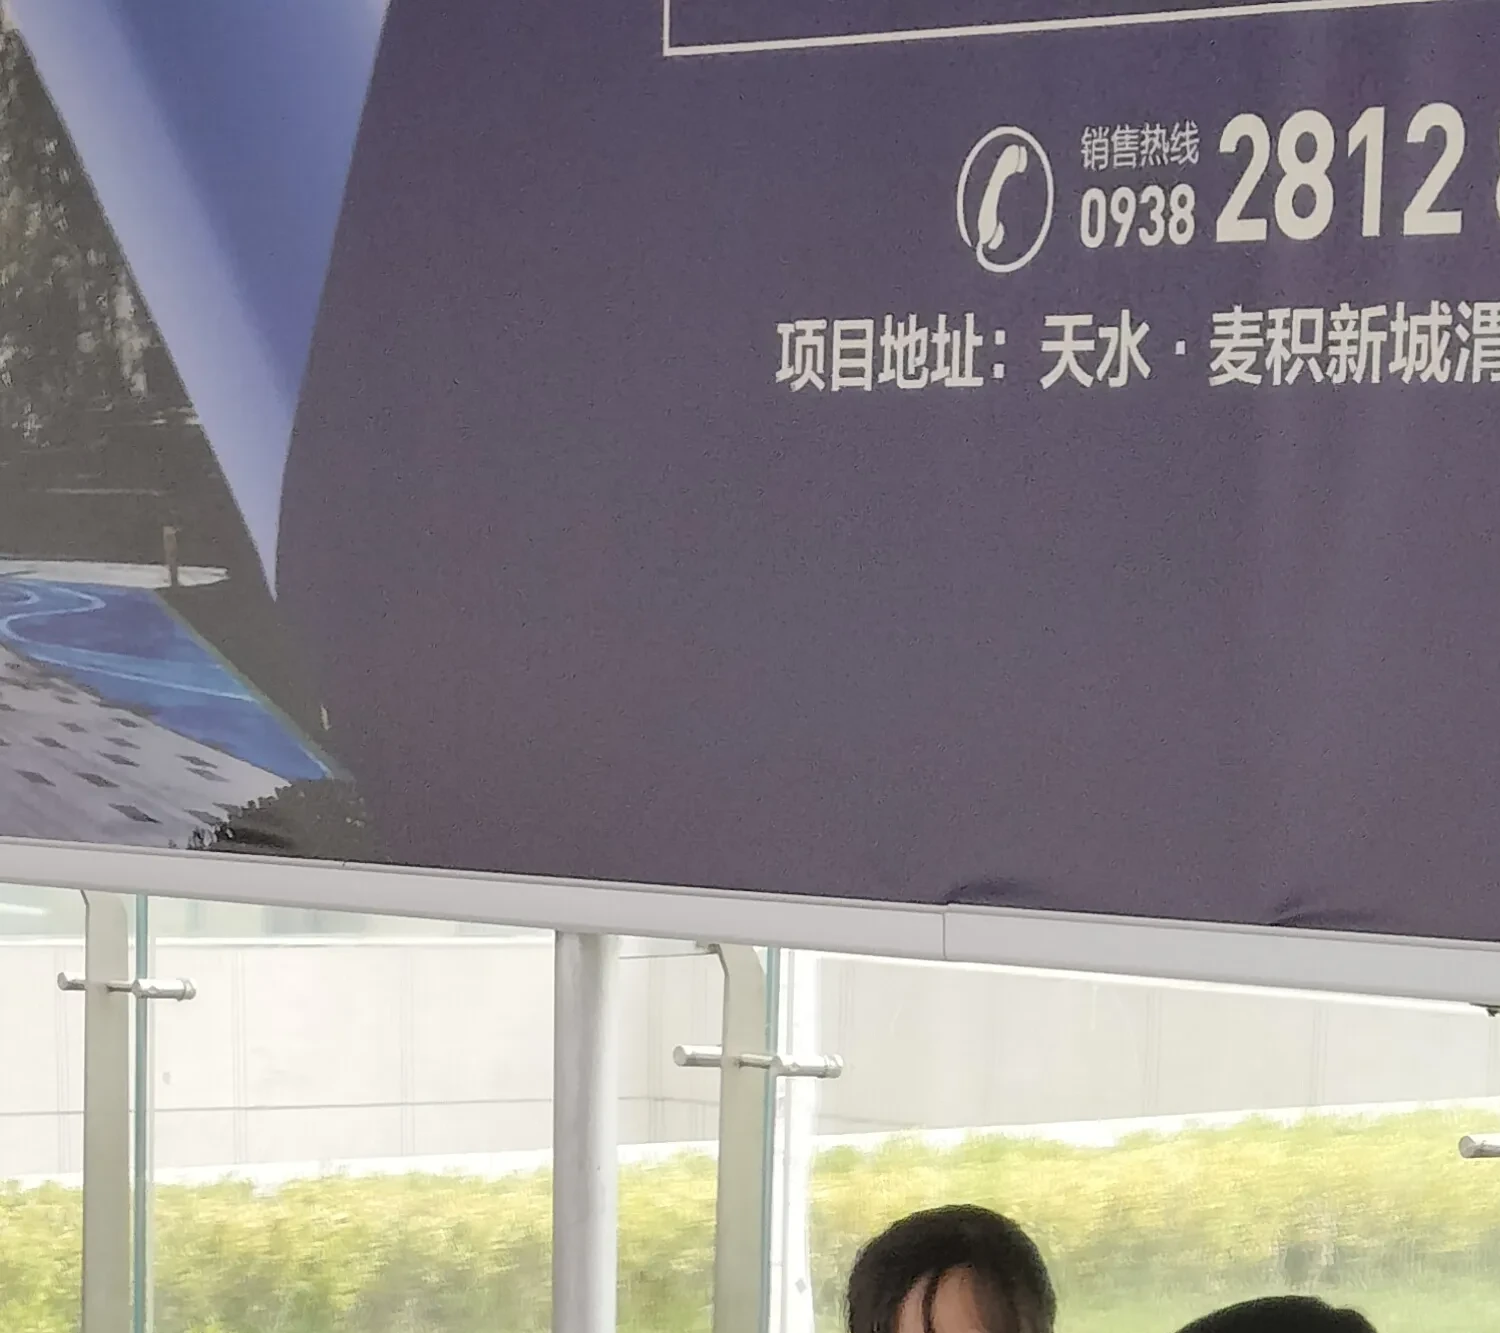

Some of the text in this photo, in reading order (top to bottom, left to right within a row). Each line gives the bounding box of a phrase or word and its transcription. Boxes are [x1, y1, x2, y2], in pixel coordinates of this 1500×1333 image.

[1079, 120, 1201, 171] 销售热线
[1079, 182, 1196, 249] 0938
[1215, 102, 1465, 243] 2812
